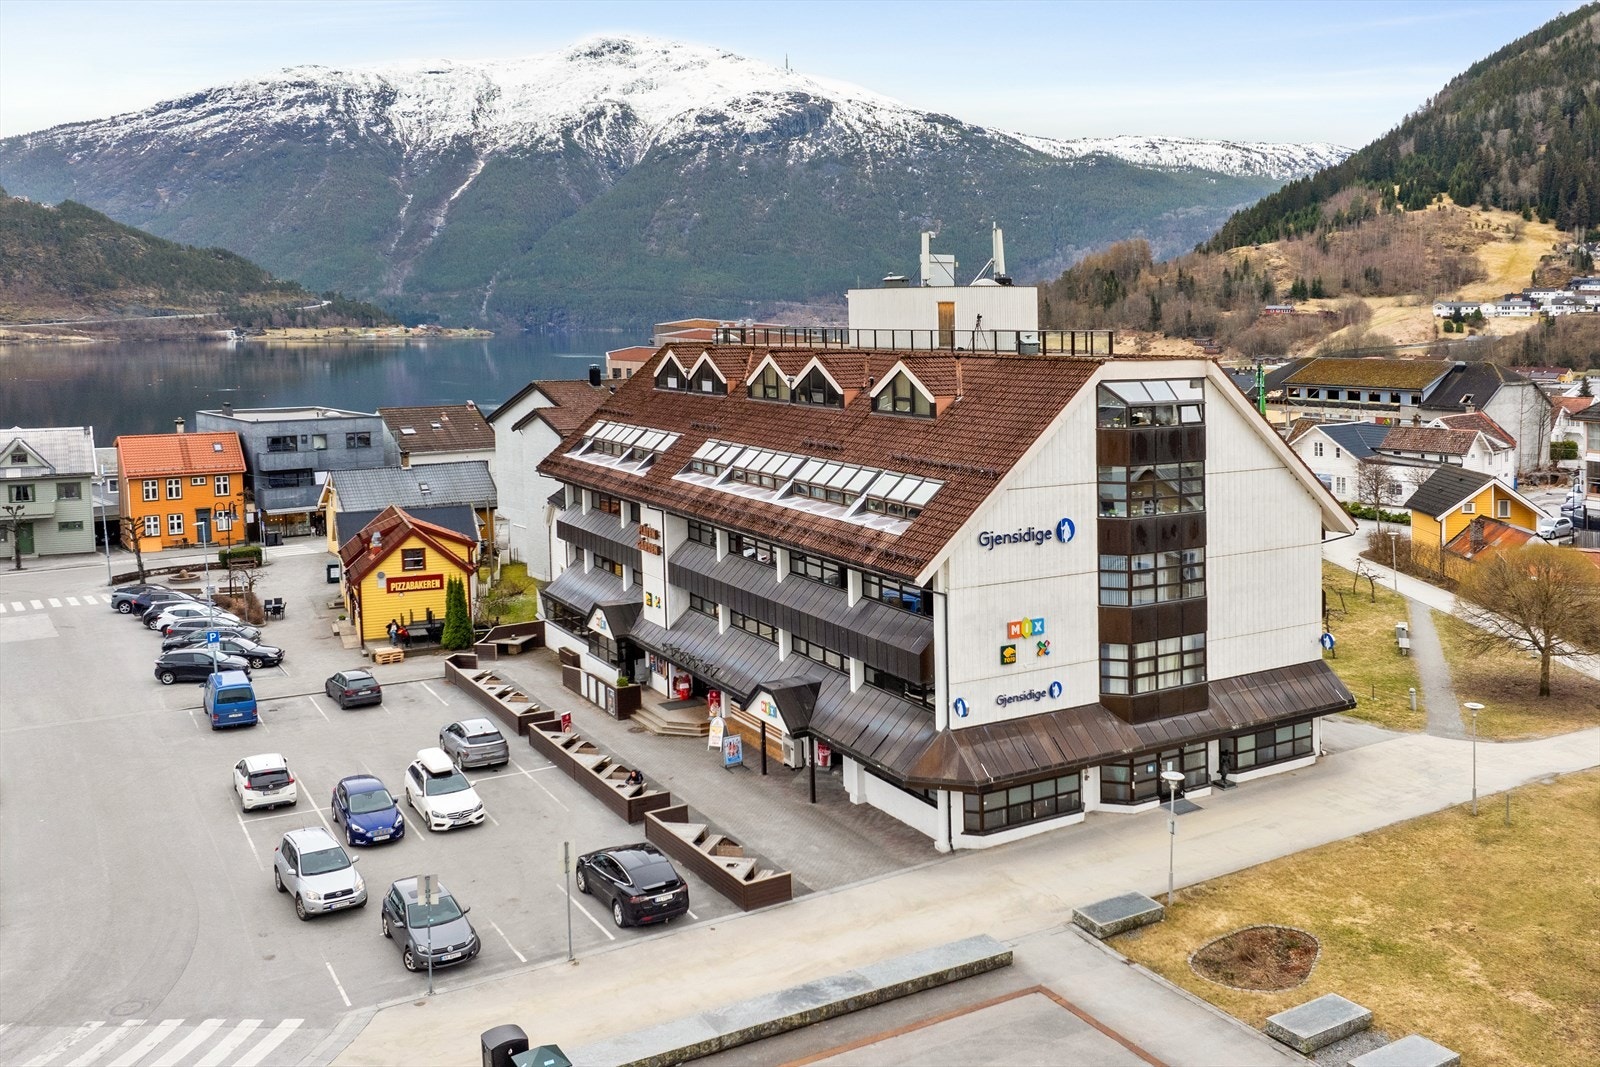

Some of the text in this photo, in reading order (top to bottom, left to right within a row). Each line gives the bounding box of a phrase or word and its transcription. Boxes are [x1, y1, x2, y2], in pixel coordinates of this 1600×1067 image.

[979, 527, 1052, 550] Gjensidige
[390, 580, 440, 592] PIZZABAKEREN
[1010, 620, 1043, 636] MIX
[210, 632, 216, 642] P
[996, 689, 1047, 708] Gjensidige
